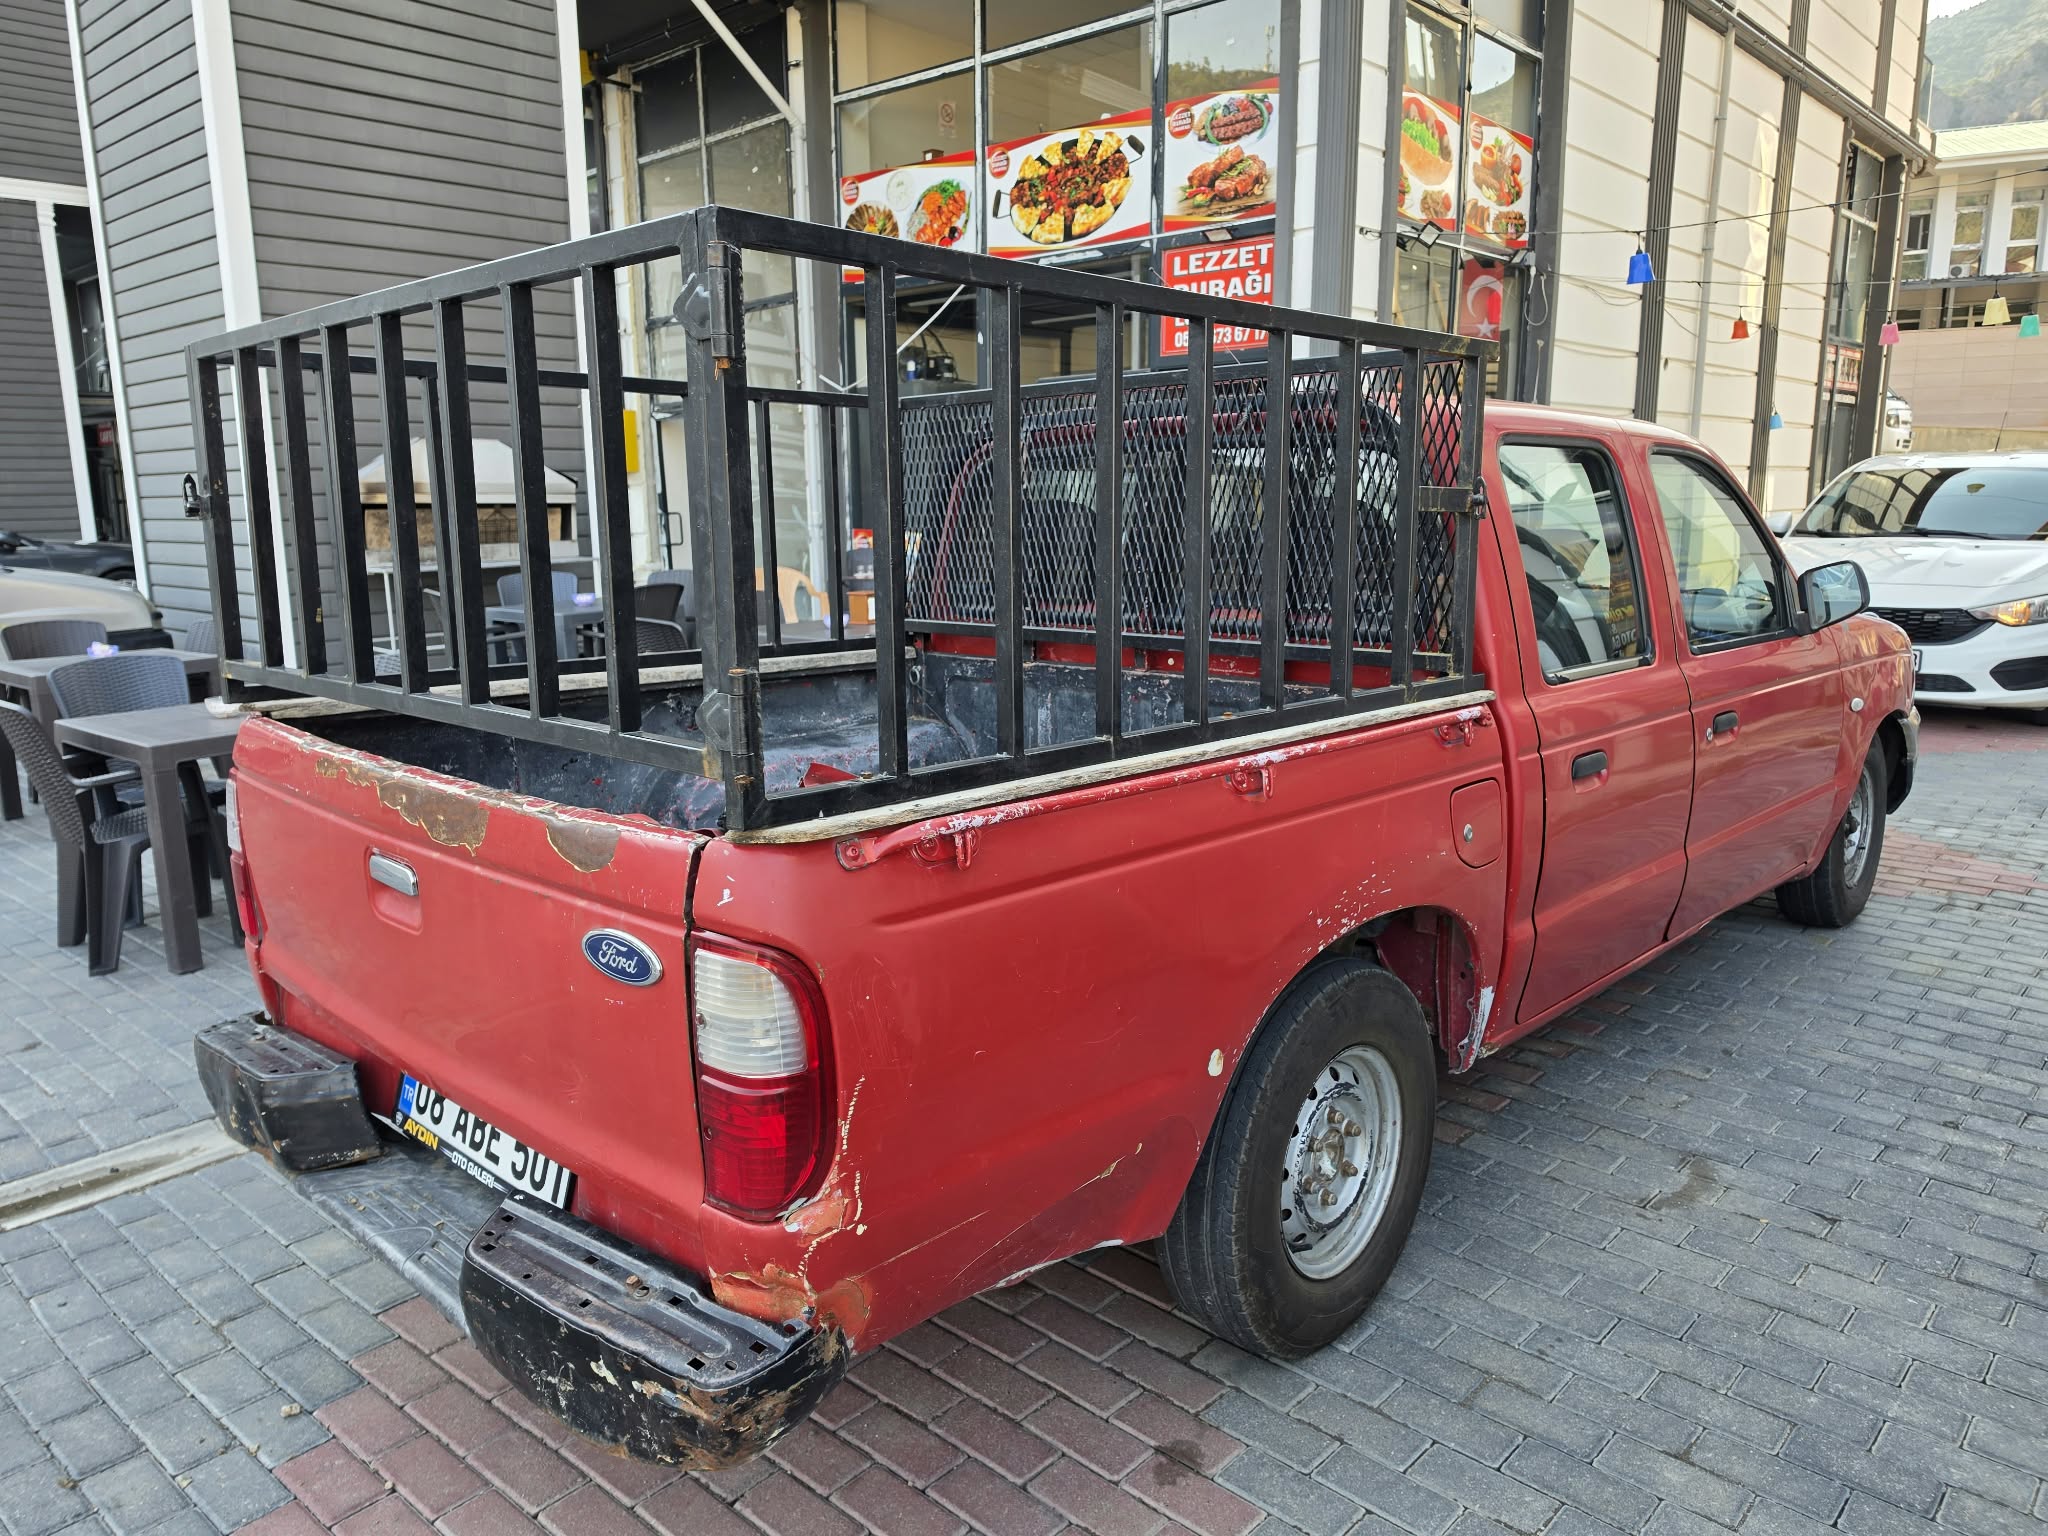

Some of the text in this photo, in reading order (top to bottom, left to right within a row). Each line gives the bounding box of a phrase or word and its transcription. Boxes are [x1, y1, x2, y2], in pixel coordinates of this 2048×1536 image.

[1173, 243, 1273, 276] LEZZET
[1234, 326, 1250, 342] 67
[598, 939, 639, 974] Ford
[404, 1084, 415, 1103] TR
[403, 1118, 439, 1151] AYDIN
[416, 1082, 446, 1126] 08
[452, 1107, 501, 1167] ABE
[451, 1151, 467, 1170] OTO
